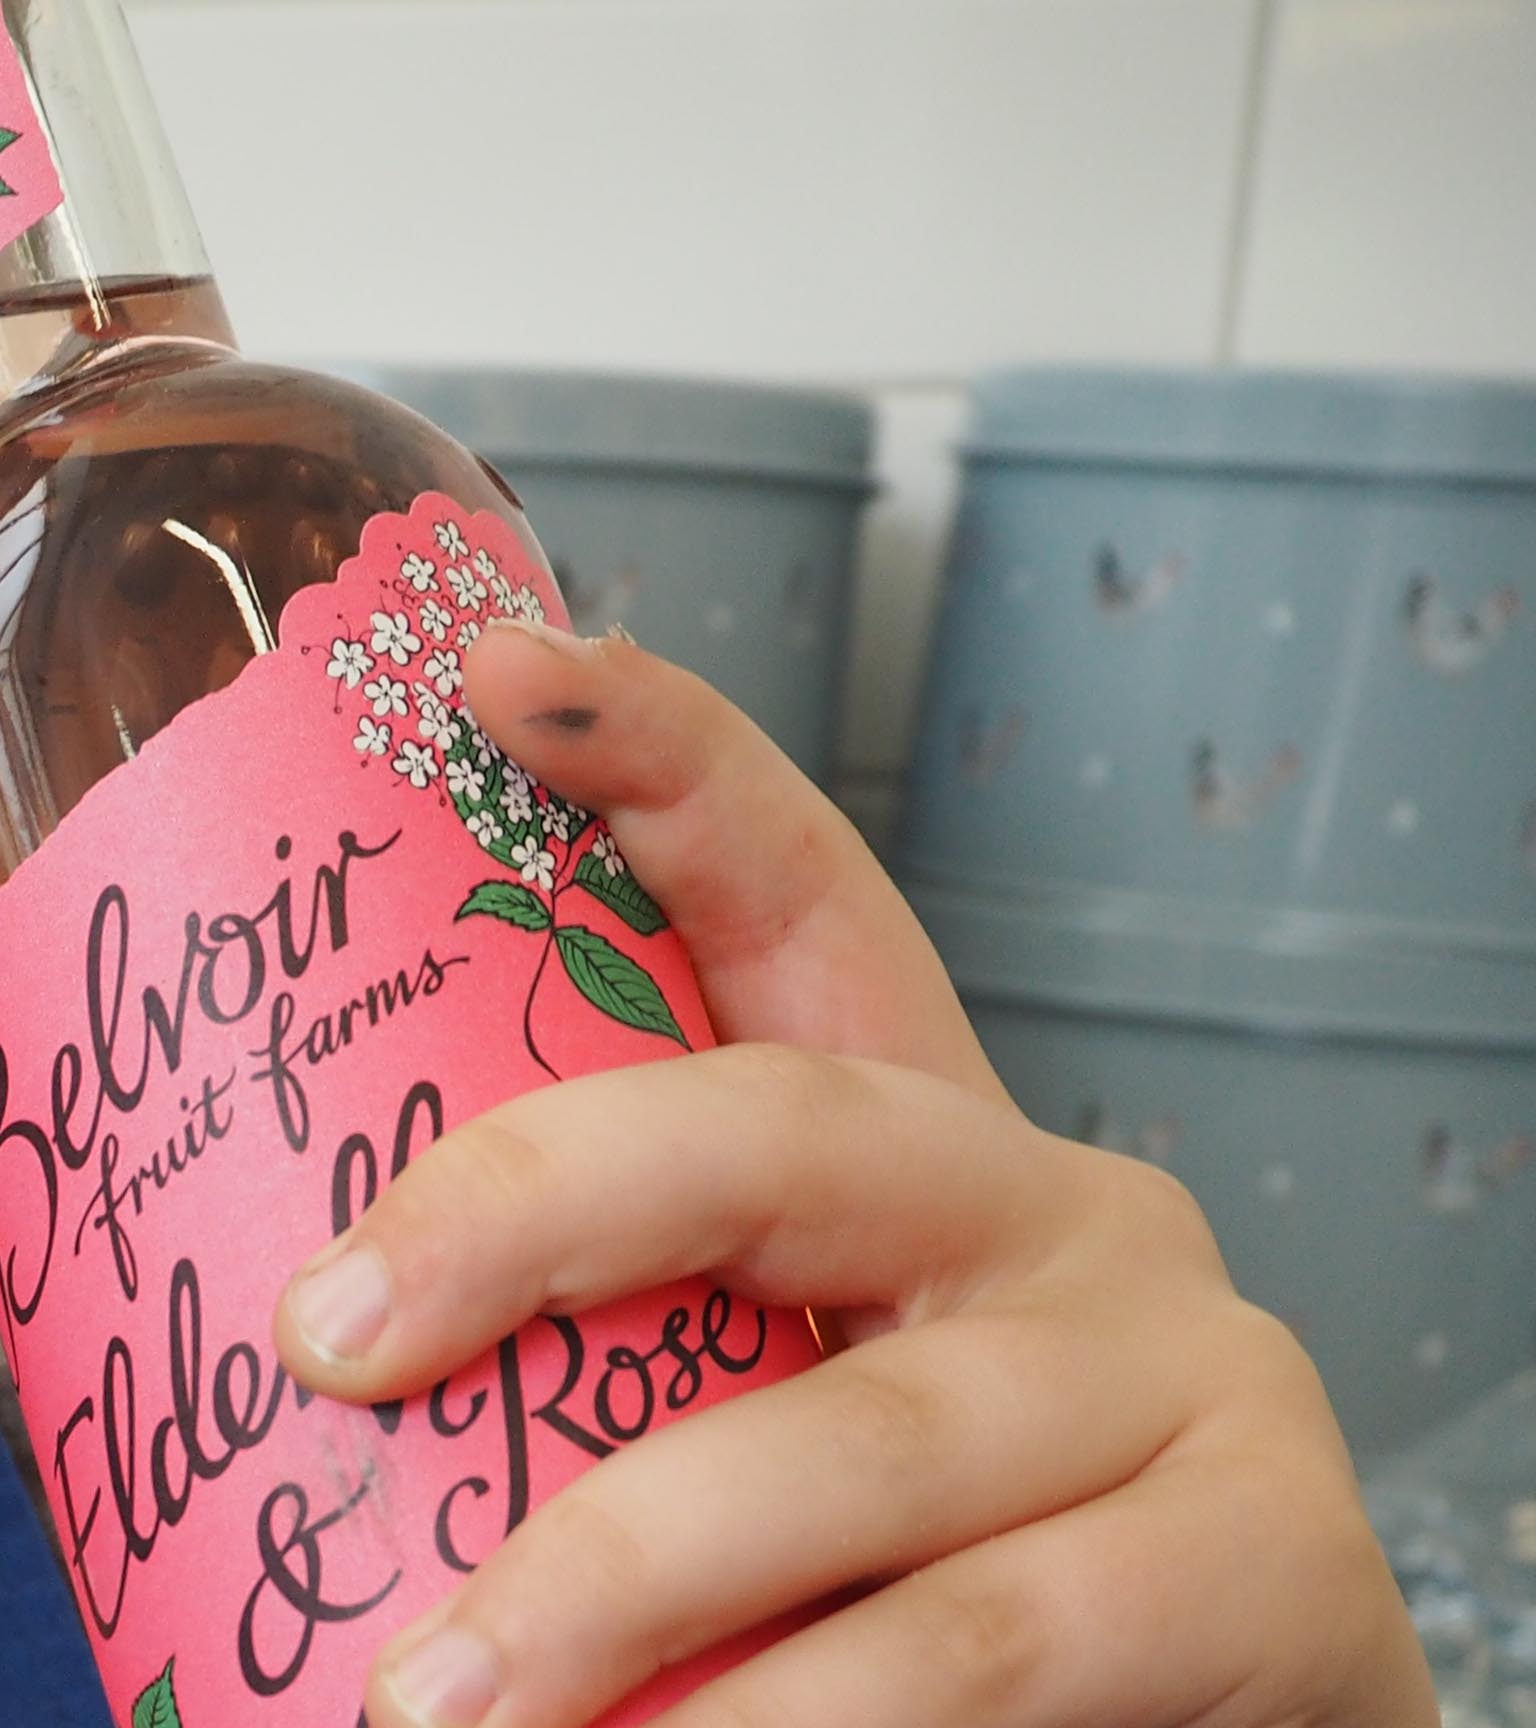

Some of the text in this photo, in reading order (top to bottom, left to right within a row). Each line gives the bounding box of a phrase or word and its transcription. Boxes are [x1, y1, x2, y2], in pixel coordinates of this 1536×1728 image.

[73, 949, 471, 1302] fruit farms
[237, 1480, 403, 1697] &
